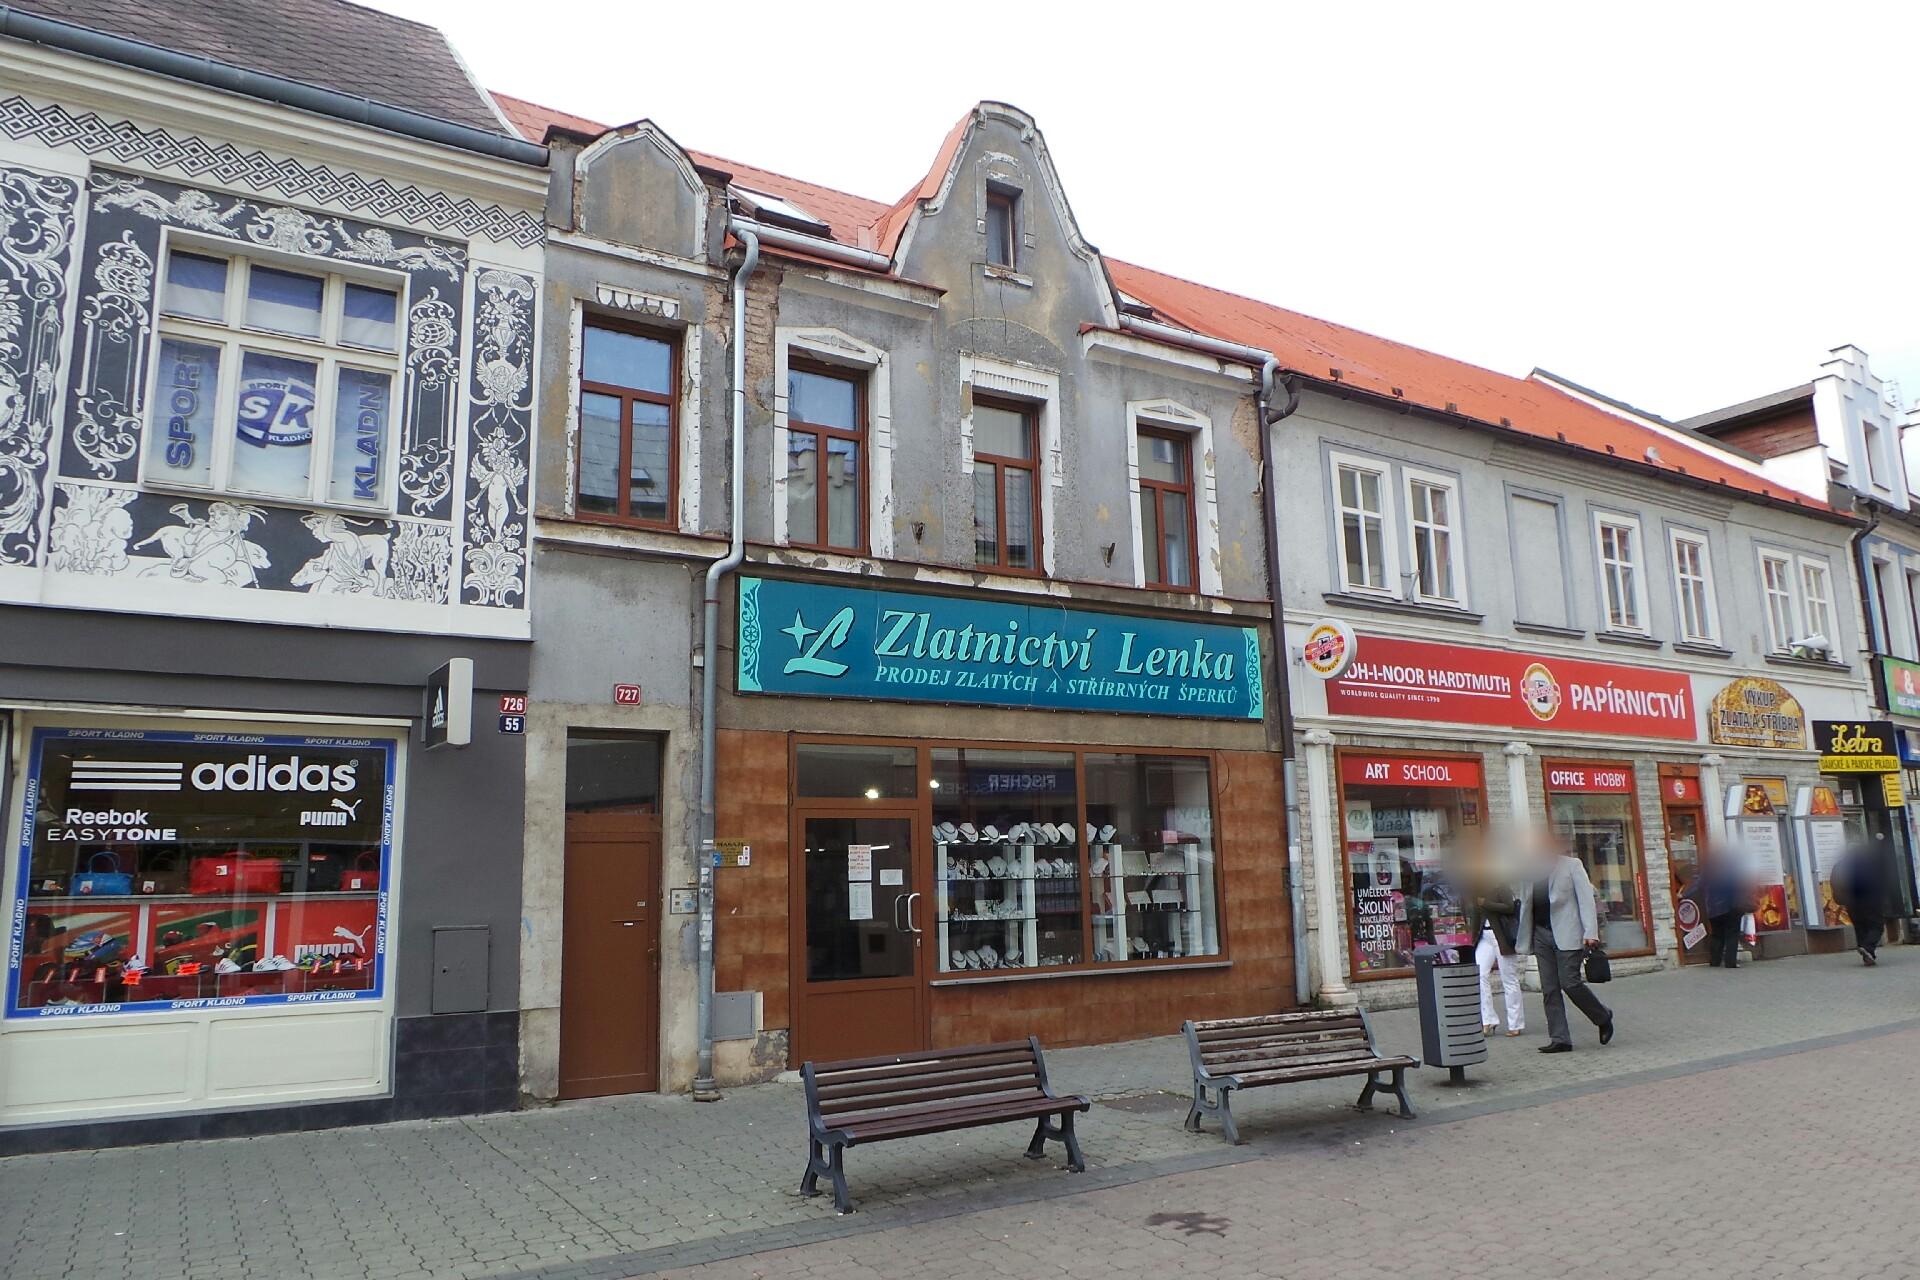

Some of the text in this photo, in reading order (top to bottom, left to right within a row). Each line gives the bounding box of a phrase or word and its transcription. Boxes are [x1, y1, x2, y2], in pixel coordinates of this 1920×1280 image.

[249, 382, 288, 391] SPORT
[268, 432, 313, 442] KLADNO
[874, 610, 1234, 681] Zlatnictví Lenka
[874, 666, 1239, 704] PRODEJ ZLATÝCH A STŘÍBRNÝCH ŠPERKŮ
[1343, 662, 1426, 686] OH-I-NOOR
[1429, 669, 1511, 693] HARDTMUTH
[618, 688, 638, 701] 727
[1340, 689, 1379, 699] WORLDWIDE
[1379, 691, 1406, 701] QUALITY
[1407, 693, 1425, 702] SINCE
[1570, 681, 1686, 719] PAPÍRNICTVÍ
[503, 697, 524, 711] 726
[505, 717, 520, 731] 55
[67, 729, 145, 739] SPORT KLADNO
[193, 734, 265, 743] SPORT KLADNO
[335, 739, 371, 747] KLADNO
[191, 755, 357, 792] adidas
[1365, 763, 1452, 781] ART SCHOOL
[1551, 770, 1626, 787] OFFICE HOBBY
[22, 778, 37, 847] SPORT KLADNO
[66, 808, 149, 825] Reebok
[300, 811, 348, 826] PUMA
[383, 784, 394, 846] SPORT KLADNO
[47, 828, 177, 841] EASYTONE
[1358, 897, 1394, 915] ŠKOLNÍ
[377, 891, 388, 954] SPORT KLADNO
[10, 898, 25, 969] SPORT KLADNO
[1360, 923, 1395, 939] HOBBY
[1361, 937, 1396, 952] POTŘEBY
[171, 997, 246, 1009] SPORT KLADNO
[287, 991, 357, 1002] SPORT KLADNO
[39, 1004, 121, 1016] SPORT KLADNO
